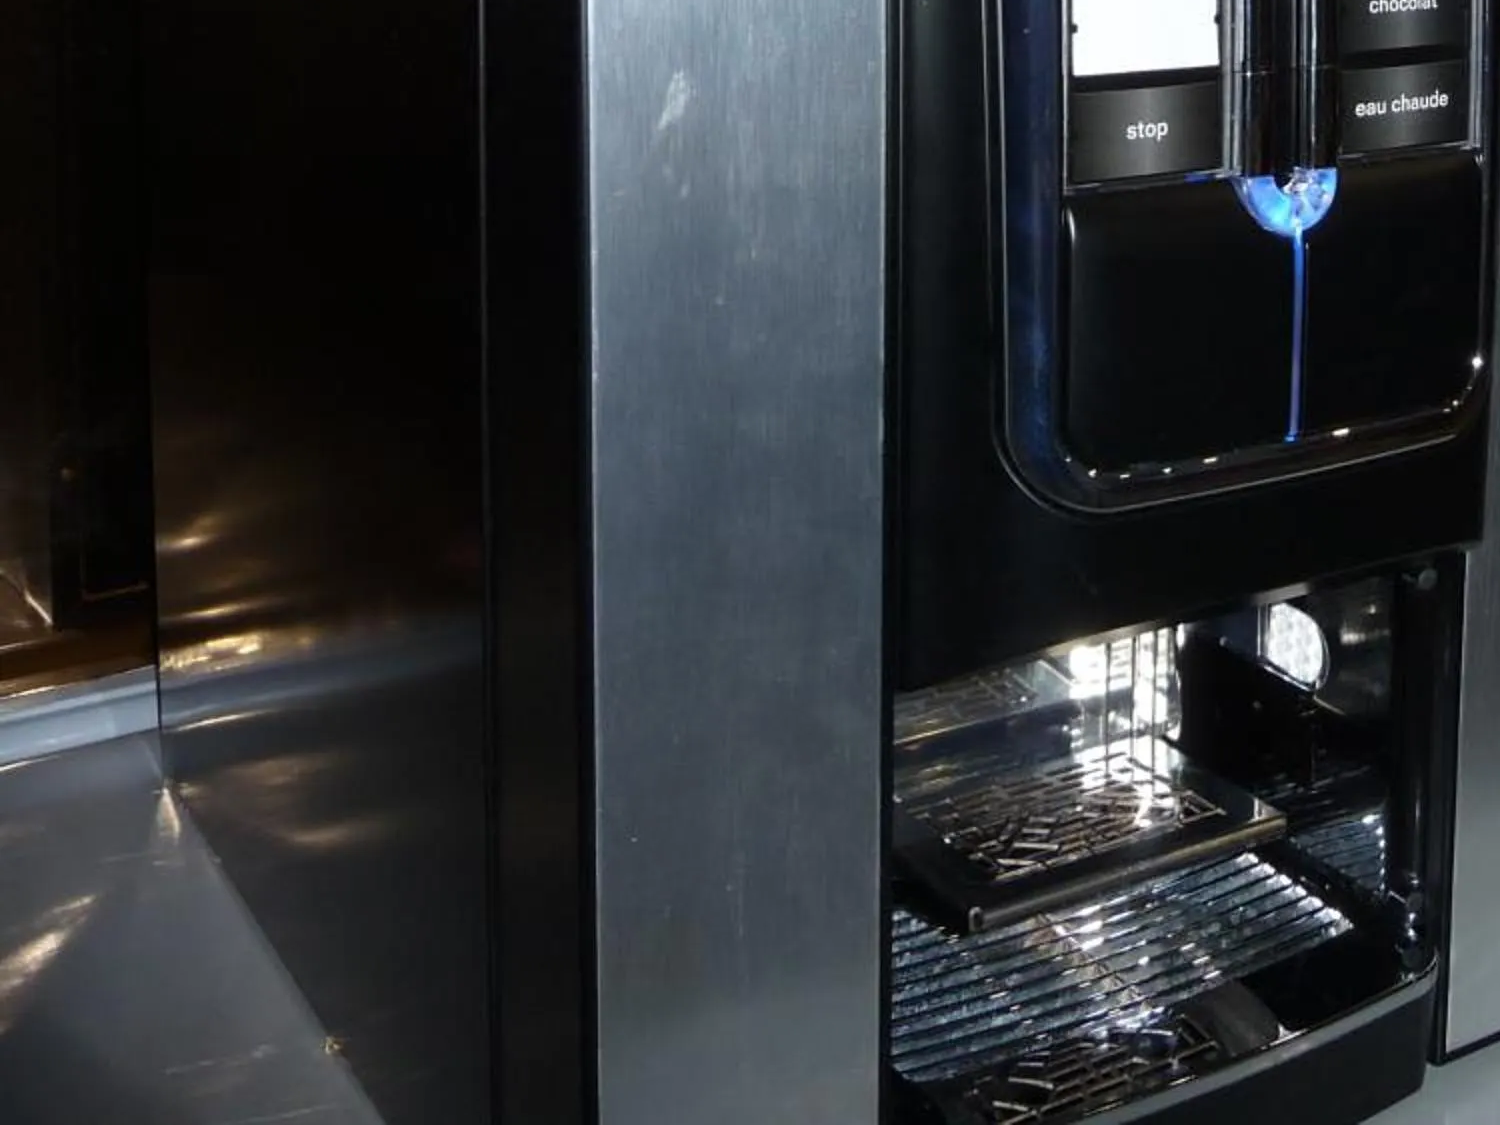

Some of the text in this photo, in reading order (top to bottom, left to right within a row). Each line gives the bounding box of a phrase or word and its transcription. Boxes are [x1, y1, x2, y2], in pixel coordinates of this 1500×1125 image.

[1355, 89, 1449, 117] eau chaude
[1126, 121, 1168, 142] stop
